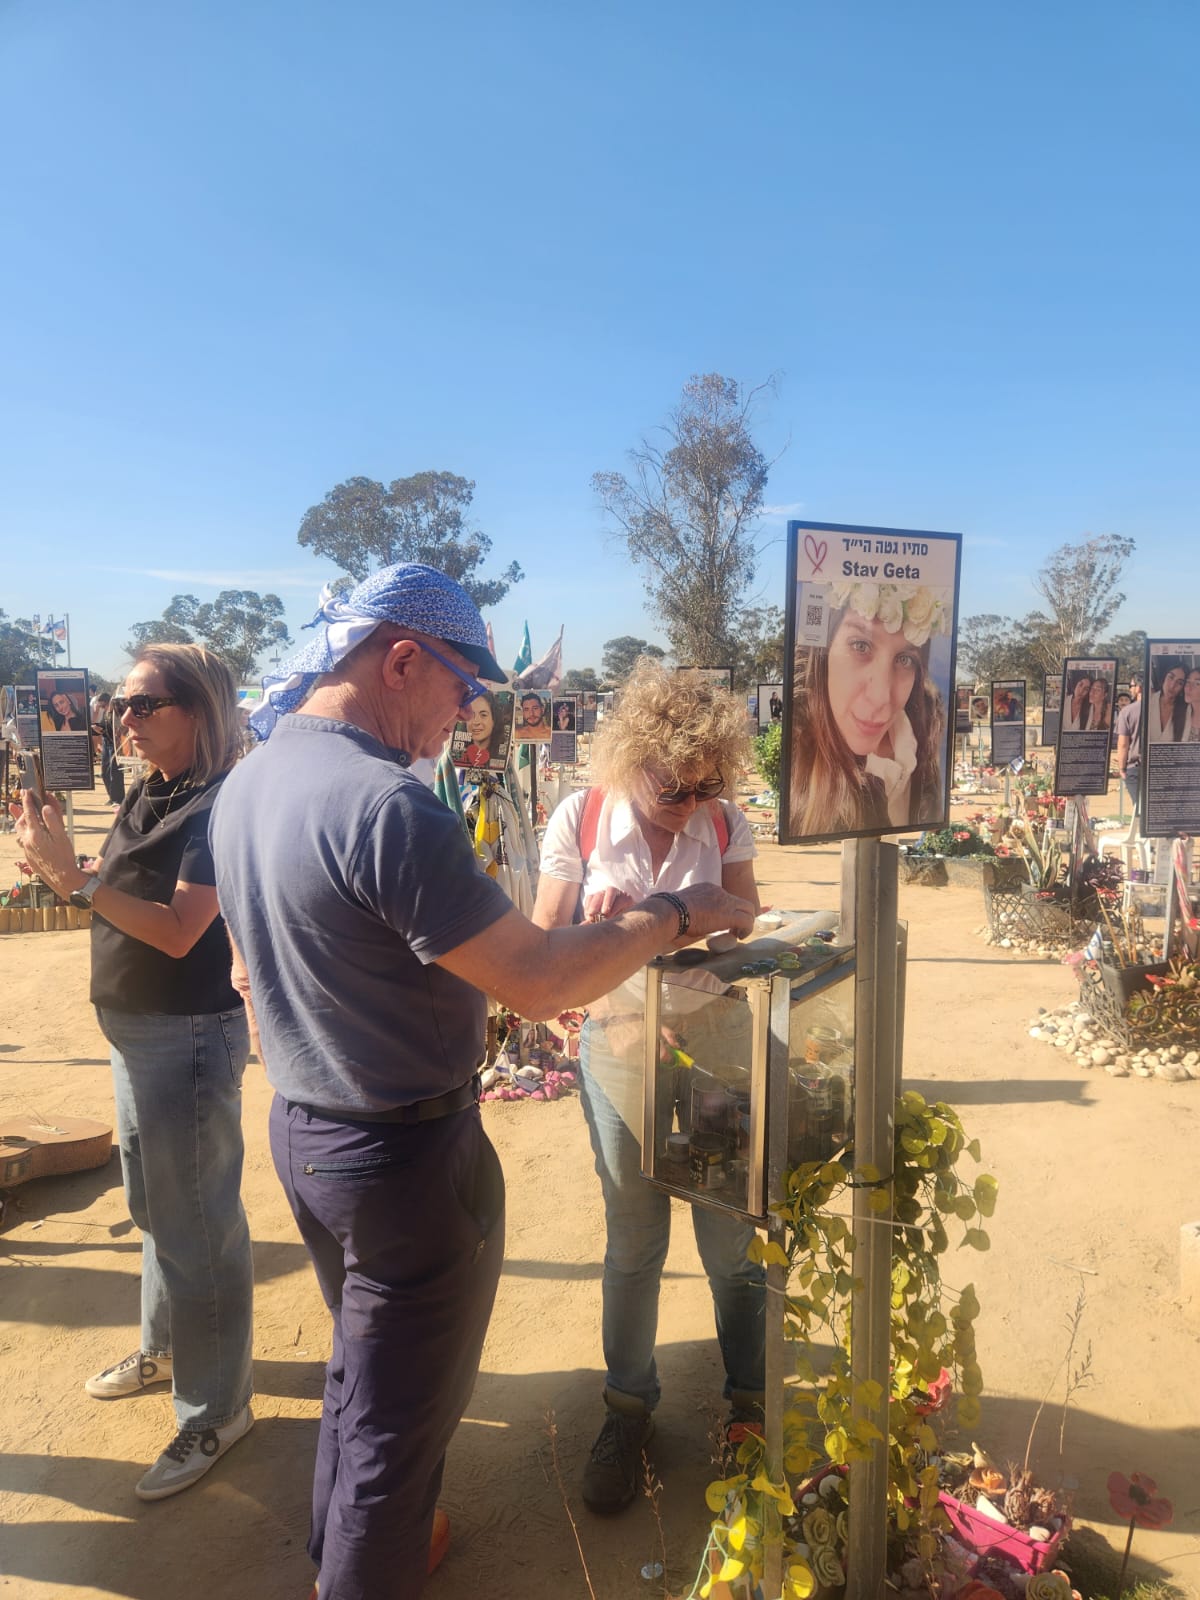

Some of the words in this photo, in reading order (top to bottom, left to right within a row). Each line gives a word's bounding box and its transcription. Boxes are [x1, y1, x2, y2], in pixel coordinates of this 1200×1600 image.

[875, 540, 899, 554] גטה
[902, 542, 929, 556] סתיו
[842, 560, 879, 577] Stav
[883, 562, 920, 579] Geta
